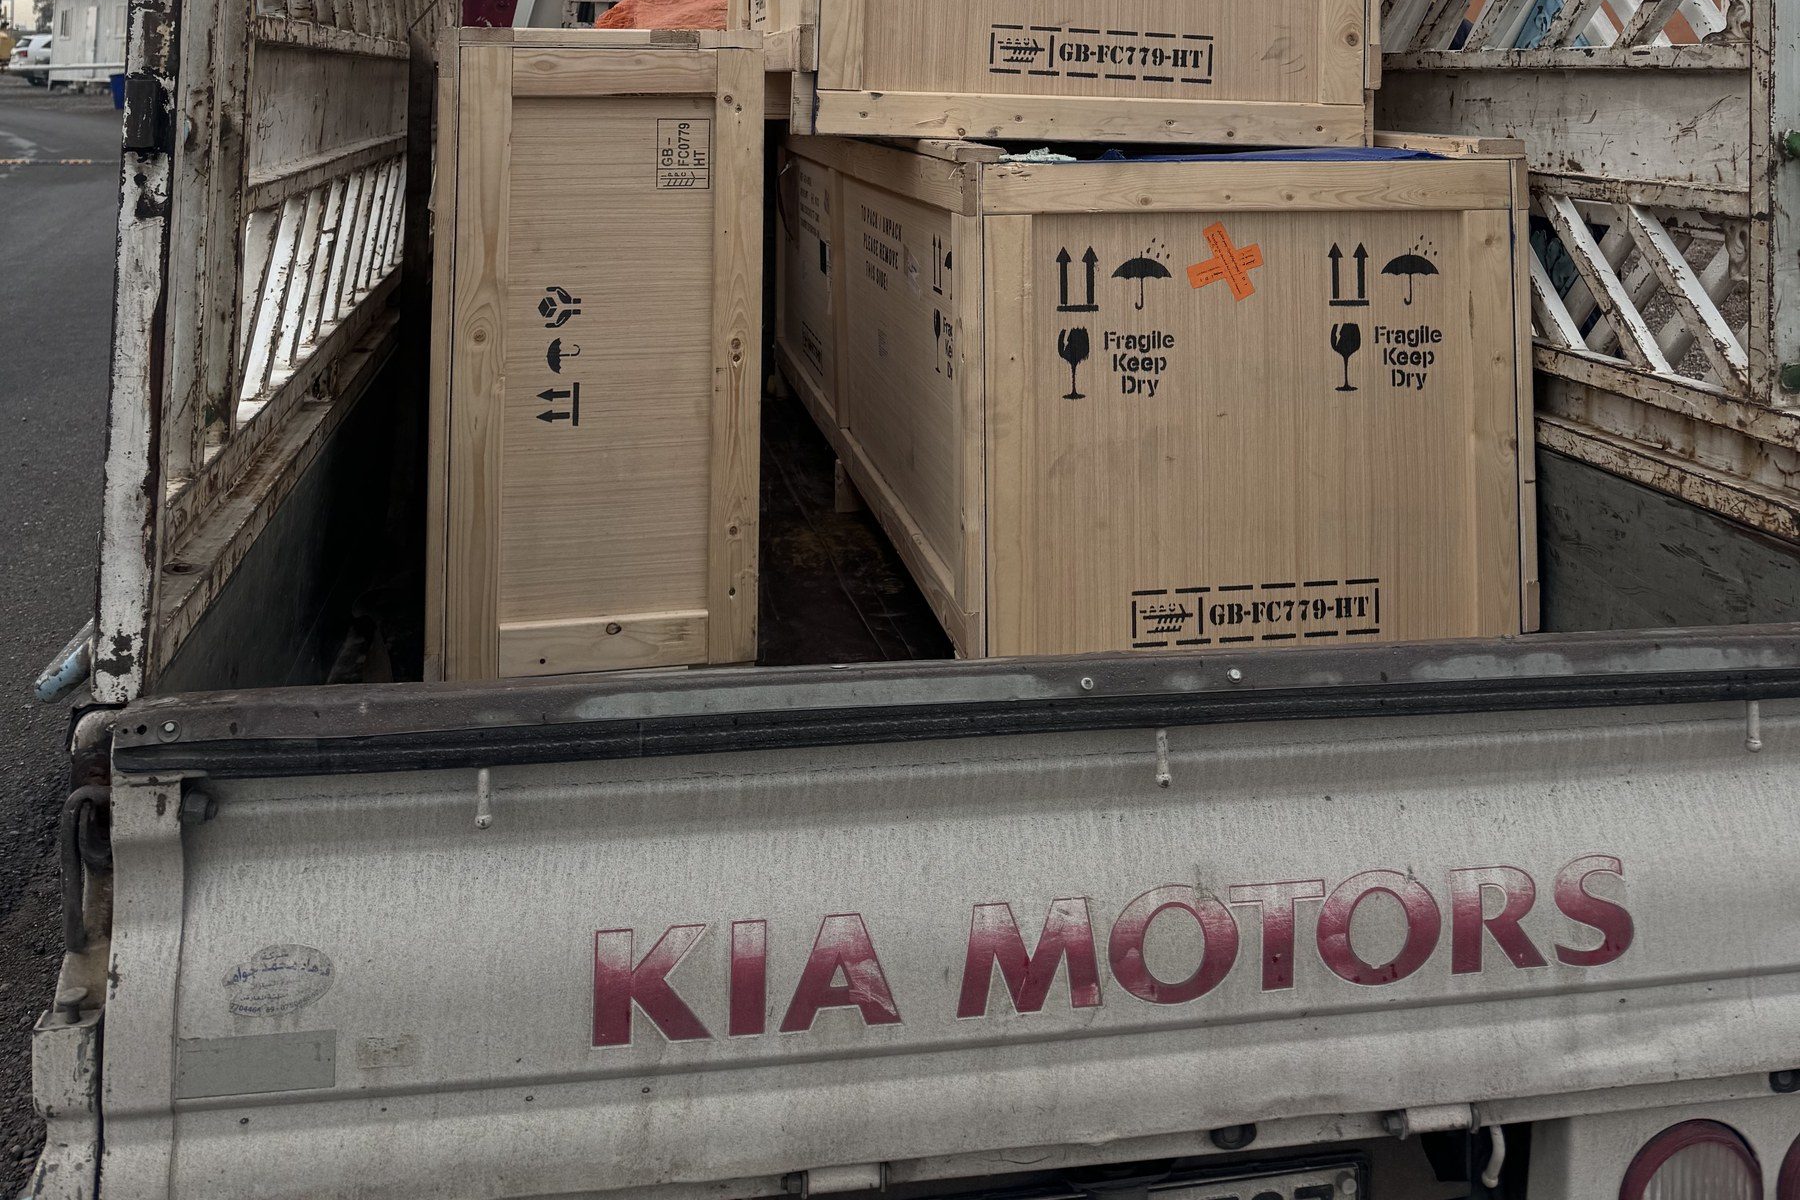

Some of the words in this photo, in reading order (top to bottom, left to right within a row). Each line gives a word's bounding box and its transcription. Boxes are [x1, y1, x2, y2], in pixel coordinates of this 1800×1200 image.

[1059, 42, 1204, 69] GB-FC779-HT
[677, 122, 690, 167] FC0779
[693, 149, 706, 167] HT
[863, 232, 879, 257] PLEASE
[879, 241, 899, 270] REMOVE
[866, 260, 875, 281] THIS
[1104, 331, 1174, 353] Fragile
[1375, 325, 1442, 347] Fragile
[1113, 351, 1167, 374] Keep
[1384, 345, 1434, 368] Keep
[1122, 375, 1159, 397] Dry
[1392, 369, 1427, 390] Dry
[1209, 596, 1369, 626] GB-FC779-HT
[591, 912, 904, 1050] KIA
[956, 854, 1635, 1019] MOTORS
